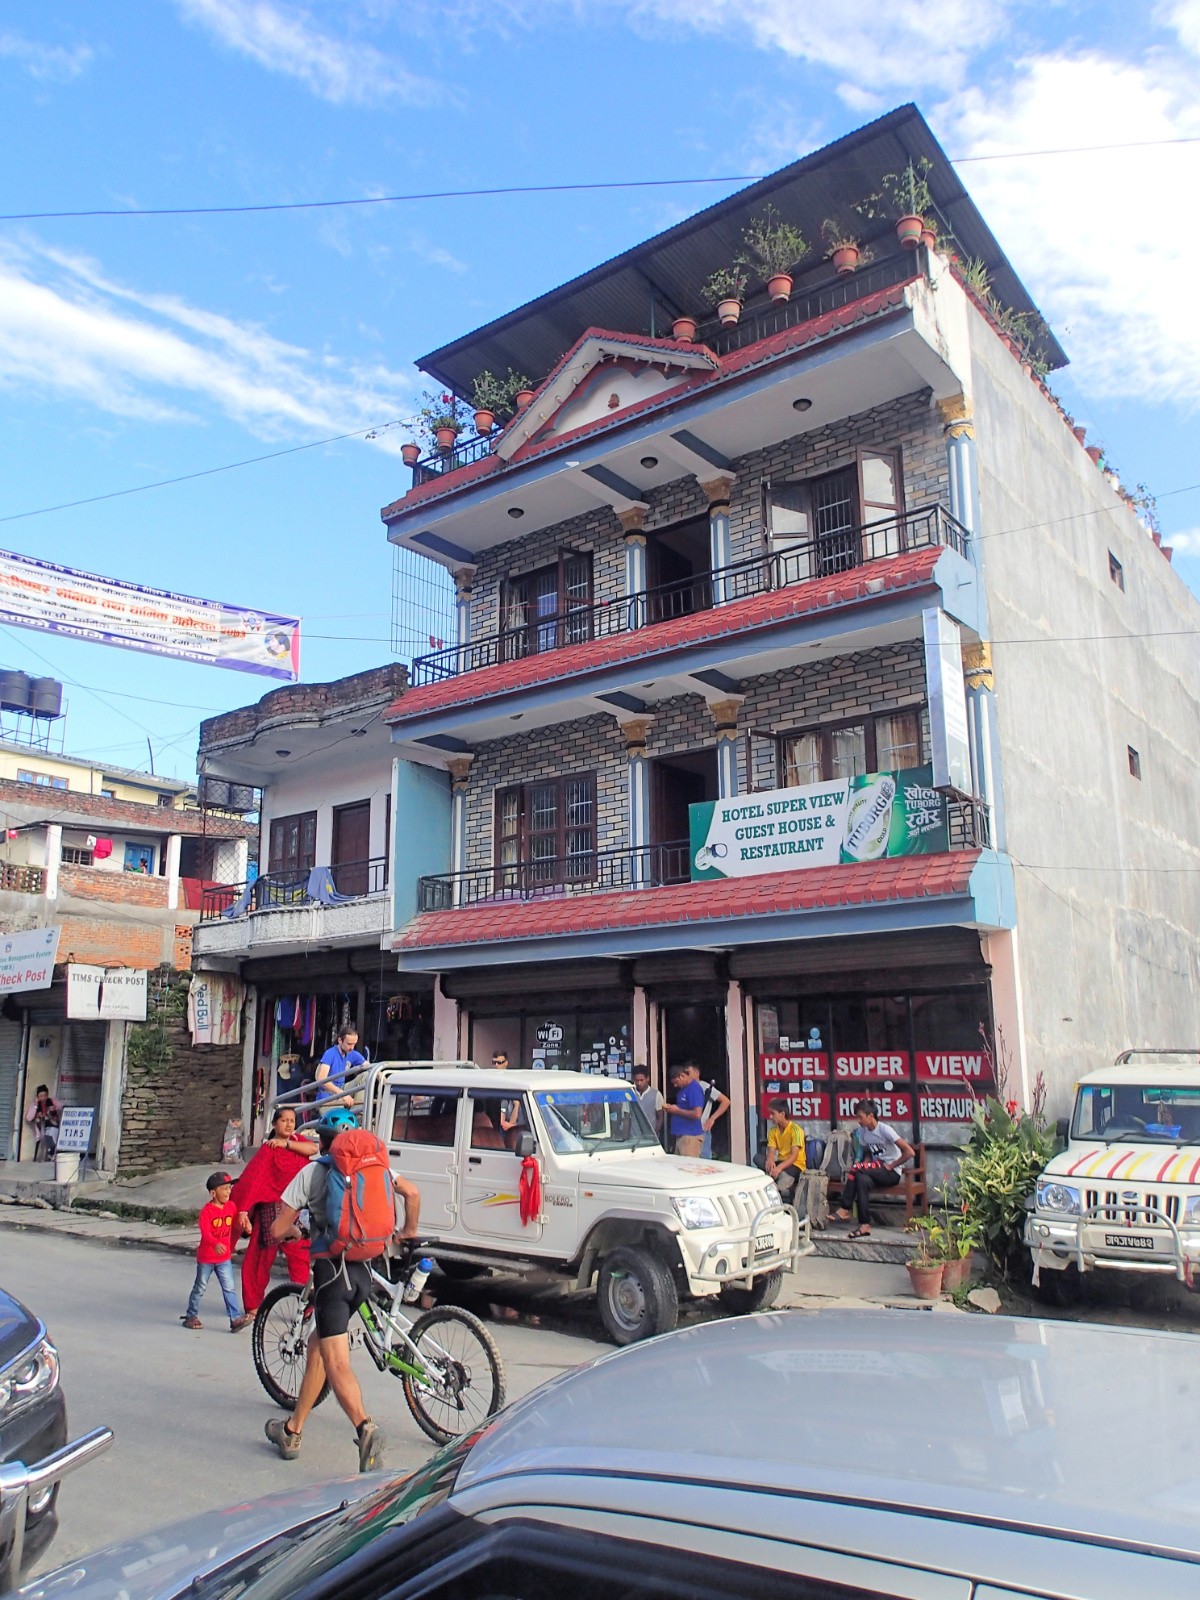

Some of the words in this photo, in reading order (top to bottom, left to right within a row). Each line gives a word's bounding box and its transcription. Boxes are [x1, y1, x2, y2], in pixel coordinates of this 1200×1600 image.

[722, 805, 764, 822] HOTEL
[767, 798, 807, 815] SUPER
[808, 792, 845, 809] VIEW
[905, 799, 940, 811] TUBORG
[735, 823, 775, 840] GUEST
[778, 816, 821, 834] HOUSE
[825, 815, 835, 827] &
[847, 796, 887, 848] TUBORG
[740, 837, 824, 860] RESTAURANT
[0, 972, 22, 985] heck
[25, 968, 46, 982] Post
[72, 973, 92, 982] TIMS
[126, 977, 145, 985] POST
[197, 1010, 208, 1030] Bull
[764, 1057, 825, 1076] HOTEL
[836, 1056, 904, 1076] SUPER
[926, 1056, 981, 1075] VIEW
[785, 1098, 821, 1117] EST
[839, 1097, 892, 1117] HOSE
[896, 1099, 908, 1115] &
[920, 1098, 991, 1118] RESTAURN
[65, 1129, 84, 1137] TIMS
[545, 1194, 570, 1203] BOLERO
